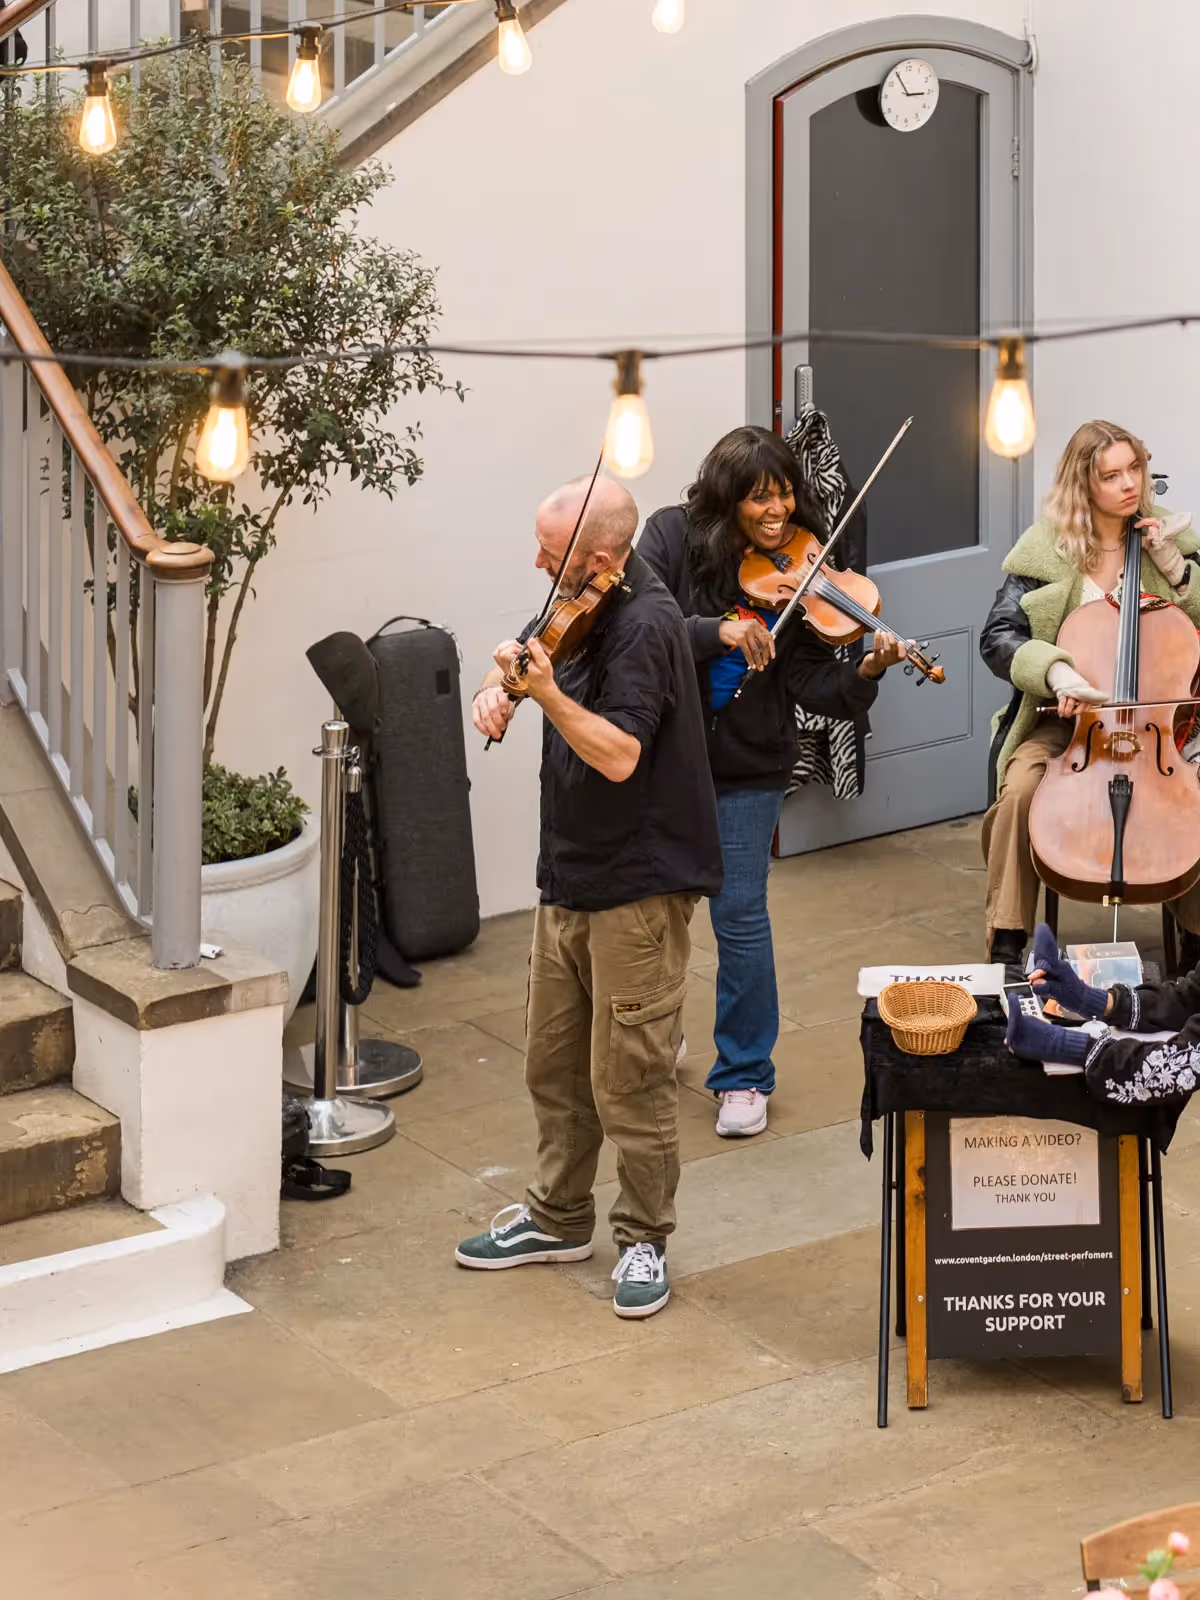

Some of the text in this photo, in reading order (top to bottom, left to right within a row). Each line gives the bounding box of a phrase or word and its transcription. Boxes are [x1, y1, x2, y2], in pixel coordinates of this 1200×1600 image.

[964, 1133, 1082, 1149] MAKING A VIDEO?
[973, 1172, 1077, 1188] PLEASE DONATE!
[995, 1192, 1056, 1204] THANK YOU
[934, 1250, 1113, 1265] www.coventgarden.london/street-perfomers
[944, 1291, 1106, 1312] THANKS FOR YOUR
[985, 1314, 1066, 1332] SUPPORT
